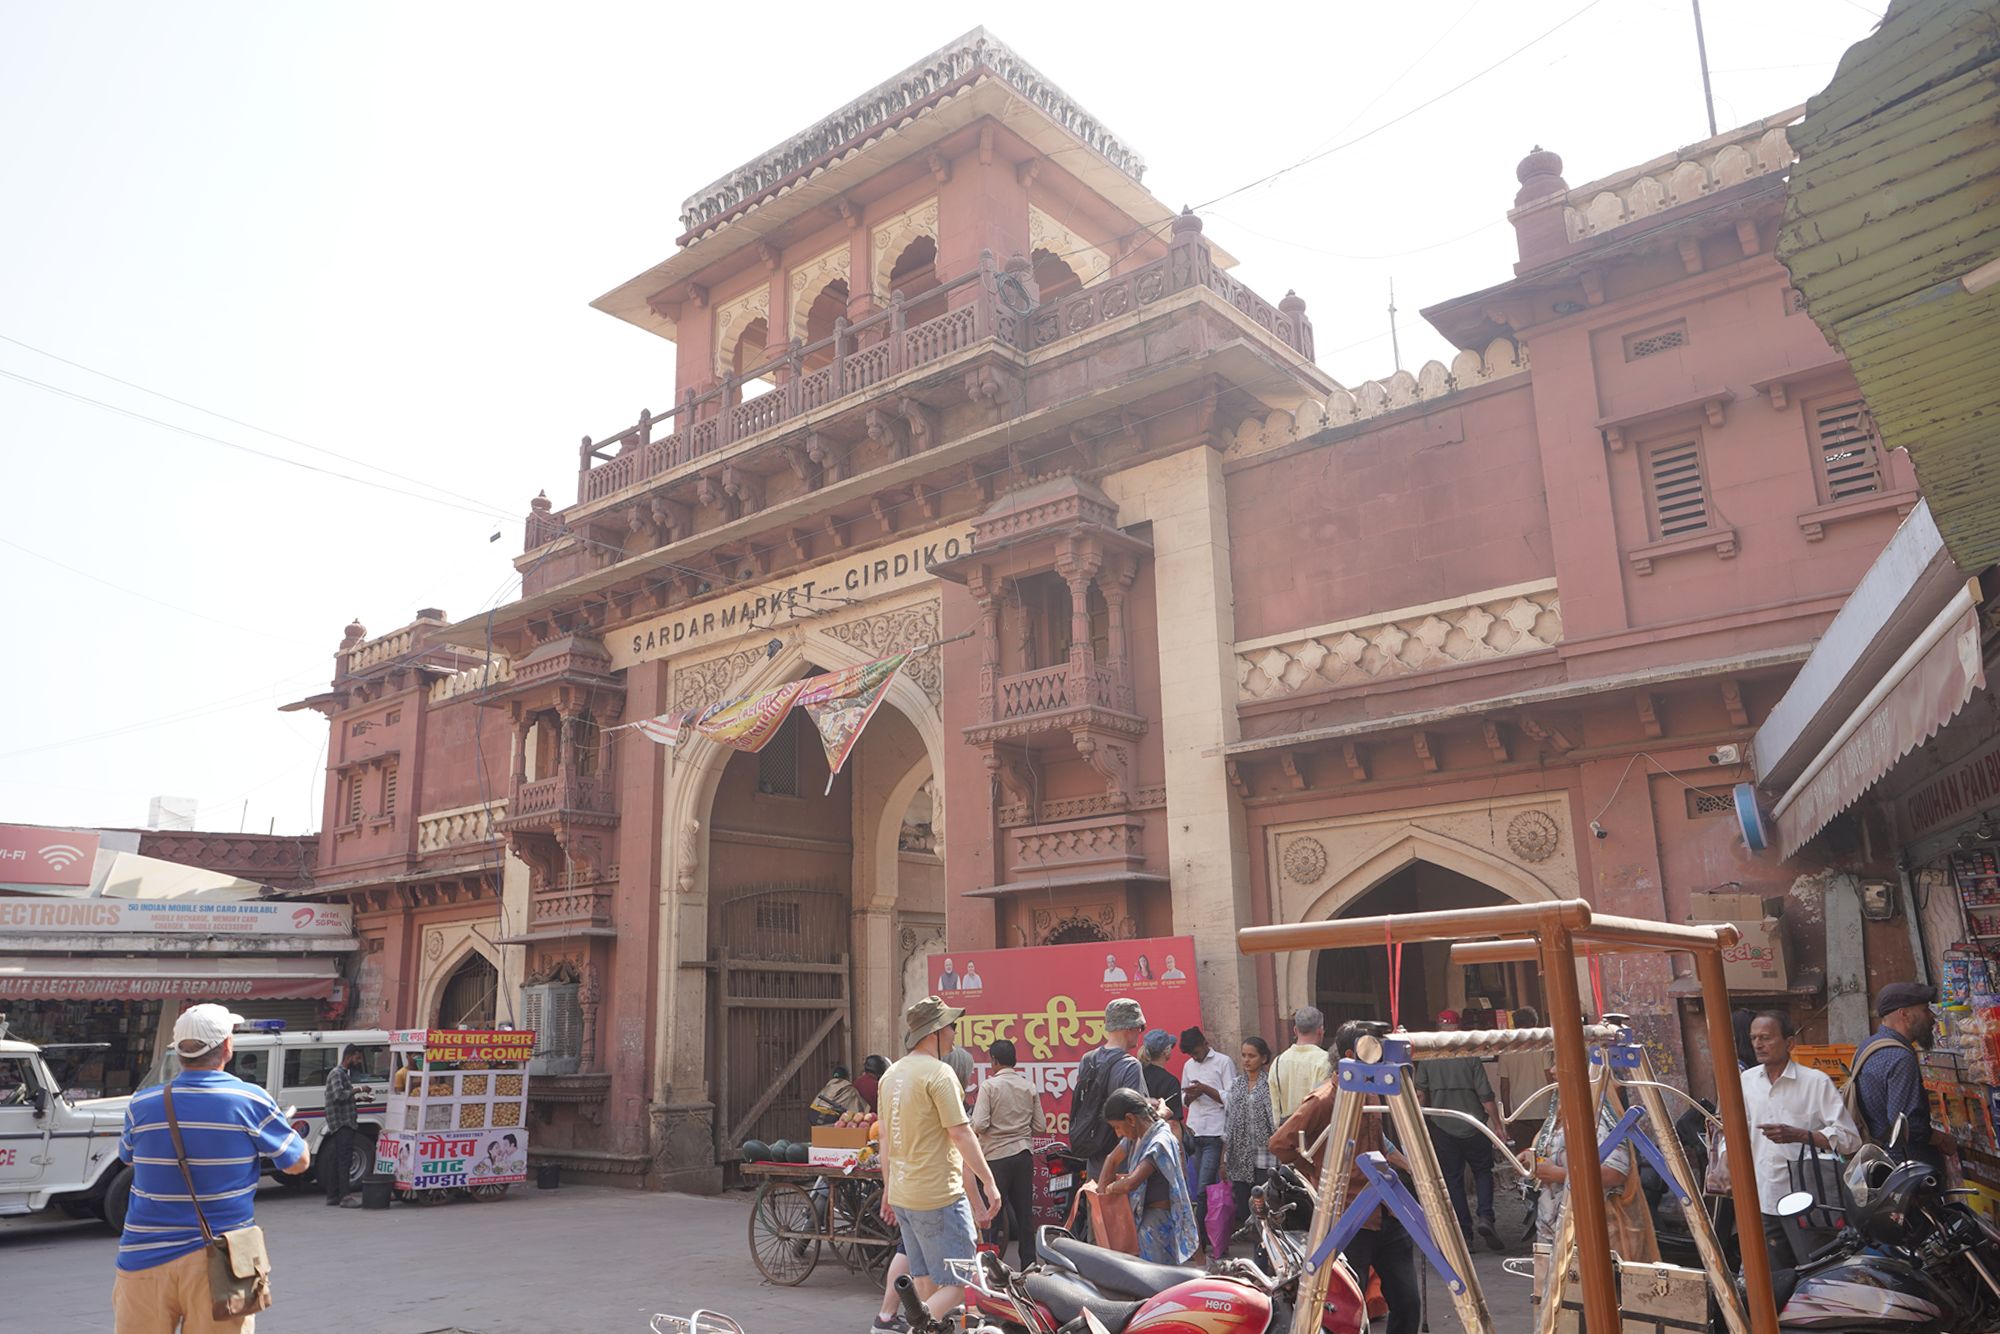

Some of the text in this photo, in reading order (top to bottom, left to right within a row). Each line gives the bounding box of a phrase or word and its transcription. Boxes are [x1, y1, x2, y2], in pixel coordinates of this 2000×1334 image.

[633, 612, 716, 655] SARDAR
[721, 581, 817, 626] MARKET
[1960, 760, 1990, 807] PAN
[0, 904, 121, 925] ECTRONICS
[168, 904, 197, 912] MOBILE
[216, 905, 237, 913] CARD
[320, 911, 340, 919] airtel
[32, 980, 127, 993] ELECTRONICS
[128, 980, 179, 993] MOBILE
[182, 980, 253, 993] REPAIRING
[428, 1030, 465, 1045] गौरव
[465, 1034, 491, 1045] चाट
[1812, 1057, 1842, 1066] Amul
[418, 1135, 478, 1159] गौरव
[376, 1160, 394, 1173] चाट
[421, 1159, 466, 1174] चाट
[1205, 1299, 1232, 1312] Hero
